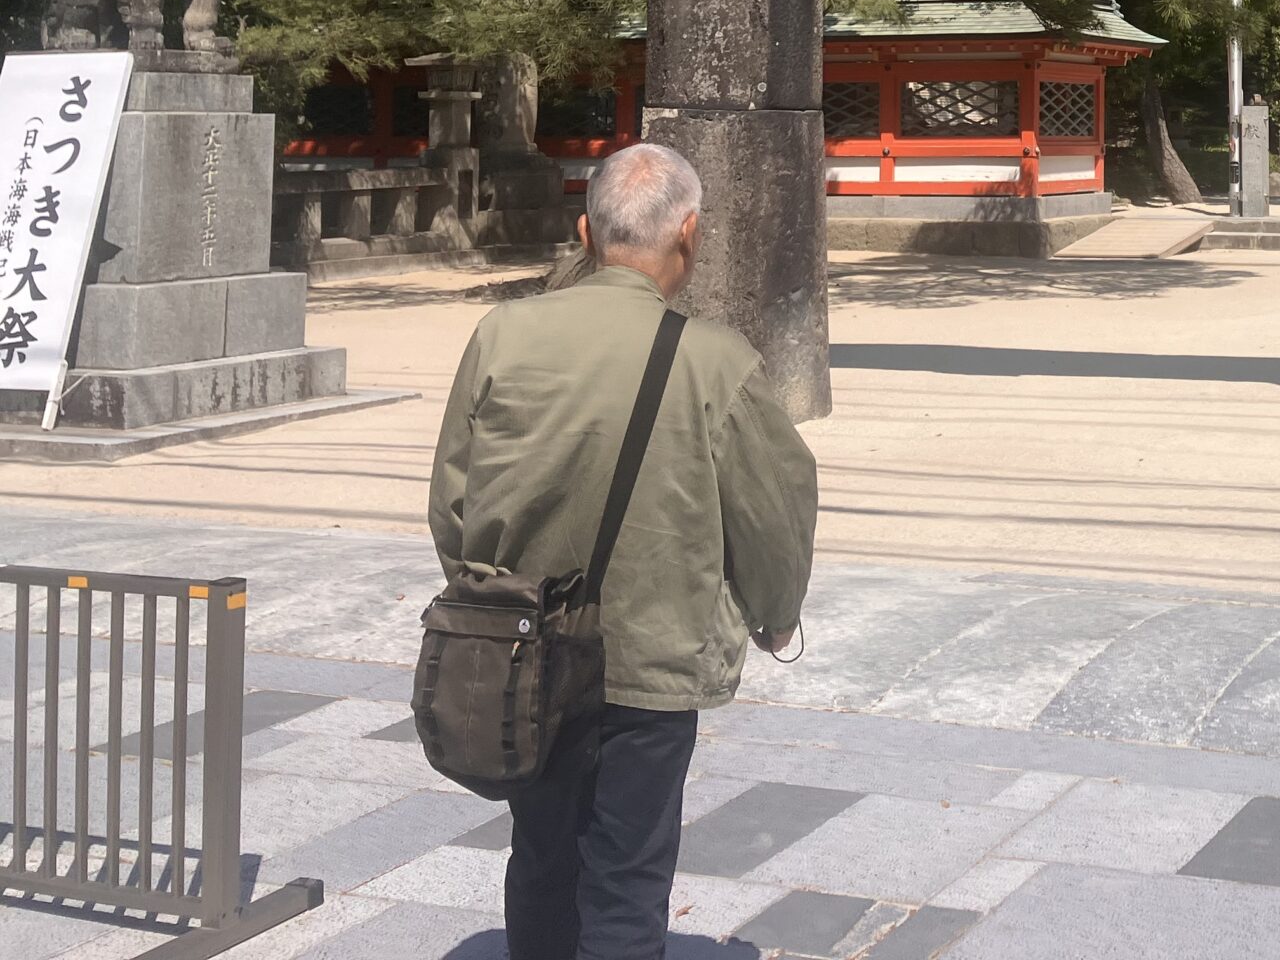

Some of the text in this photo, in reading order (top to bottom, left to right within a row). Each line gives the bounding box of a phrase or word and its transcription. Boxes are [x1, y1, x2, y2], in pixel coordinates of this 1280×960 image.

[0, 76, 92, 369] さつき大祭
